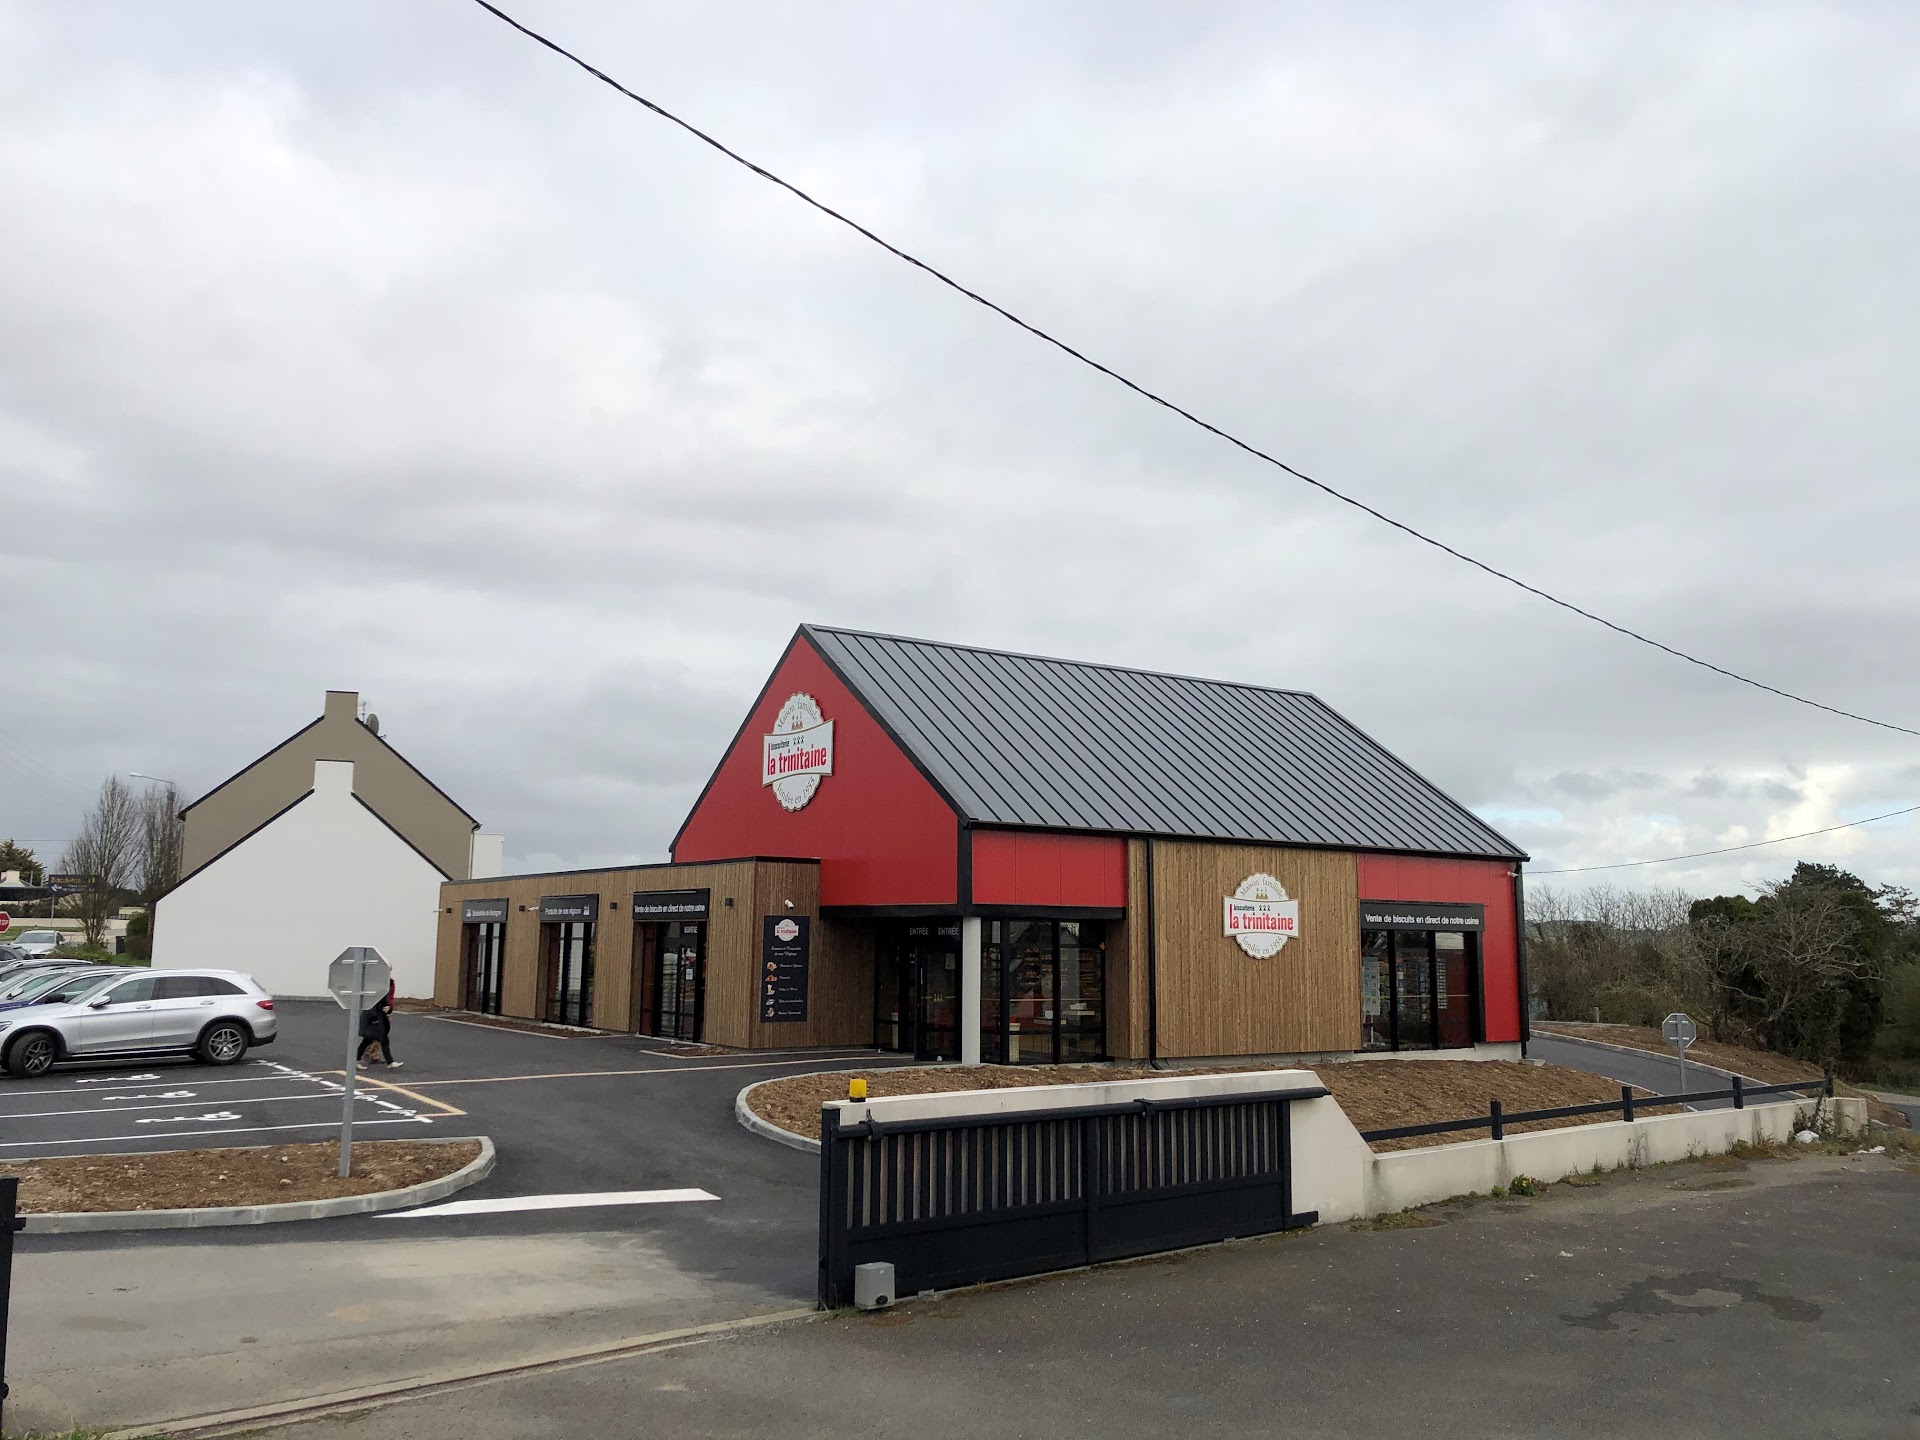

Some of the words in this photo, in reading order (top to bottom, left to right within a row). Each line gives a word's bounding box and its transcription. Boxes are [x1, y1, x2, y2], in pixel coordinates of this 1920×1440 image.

[777, 703, 795, 730] Maison
[771, 739, 790, 750] biscuiterie
[768, 742, 776, 776] la
[778, 744, 826, 774] trinitaine
[1240, 880, 1260, 896] Maison
[634, 905, 644, 913] Vente
[650, 904, 662, 913] biscuits
[668, 904, 678, 912] direct
[684, 904, 694, 912] notre
[694, 903, 705, 912] usine
[1230, 904, 1239, 929] la
[1242, 912, 1294, 930] trinitaine
[1365, 914, 1382, 923] Vente
[1384, 914, 1392, 923] de
[1392, 914, 1415, 924] biscuits
[1425, 915, 1440, 924] direct
[1441, 916, 1449, 924] de
[1450, 917, 1464, 925] notre
[1464, 916, 1479, 925] usine
[910, 926, 929, 935] ENTRÉE
[938, 926, 959, 935] ENTRÉE
